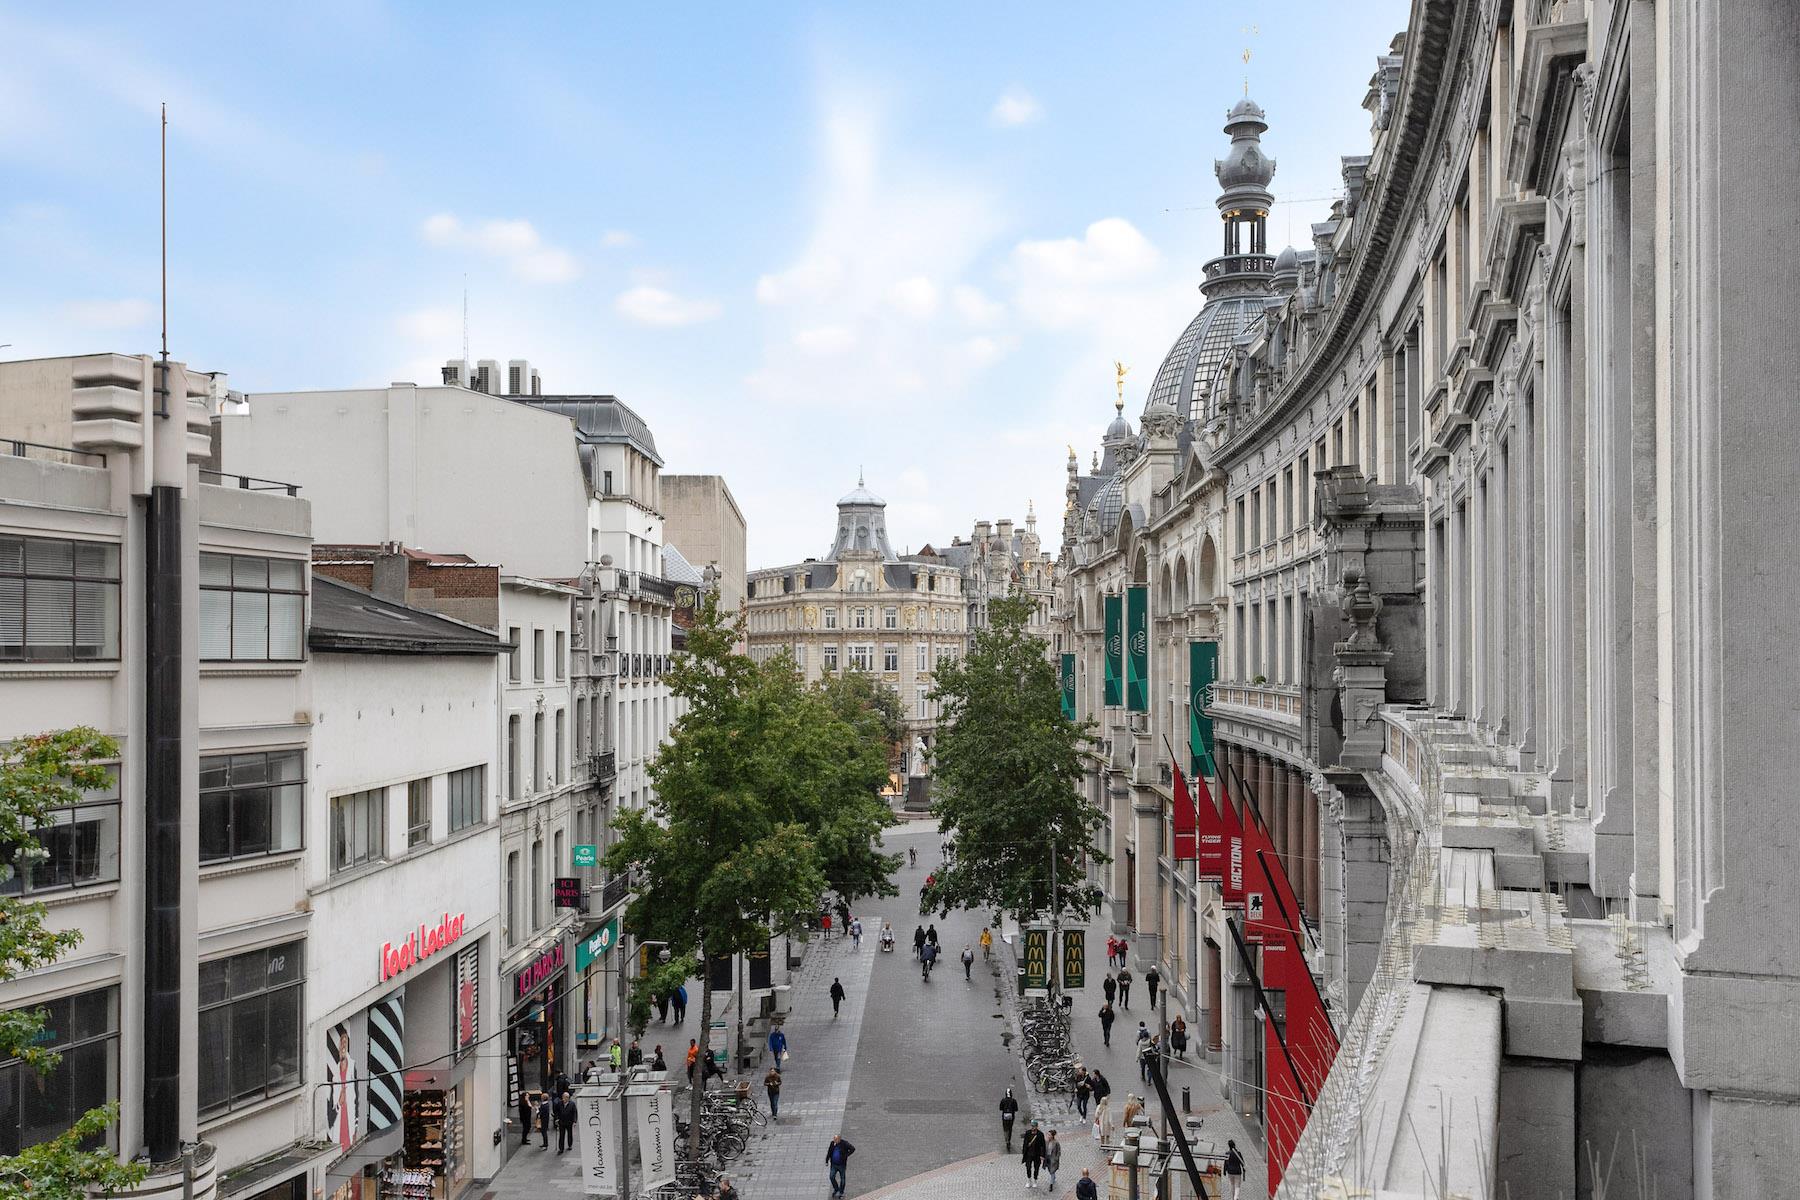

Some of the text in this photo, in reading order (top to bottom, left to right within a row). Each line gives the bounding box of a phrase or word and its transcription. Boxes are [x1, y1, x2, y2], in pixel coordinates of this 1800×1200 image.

[1137, 630, 1146, 654] INNO
[555, 888, 579, 897] PARIS
[561, 880, 573, 888] ICI
[561, 898, 572, 906] XL
[417, 911, 465, 961] Locker
[519, 943, 565, 996] ICI PARIS XL
[588, 1098, 602, 1128] Dutti
[647, 1097, 662, 1125] Dutti
[592, 1130, 607, 1179] Massimo
[651, 1126, 664, 1173] Massimo
